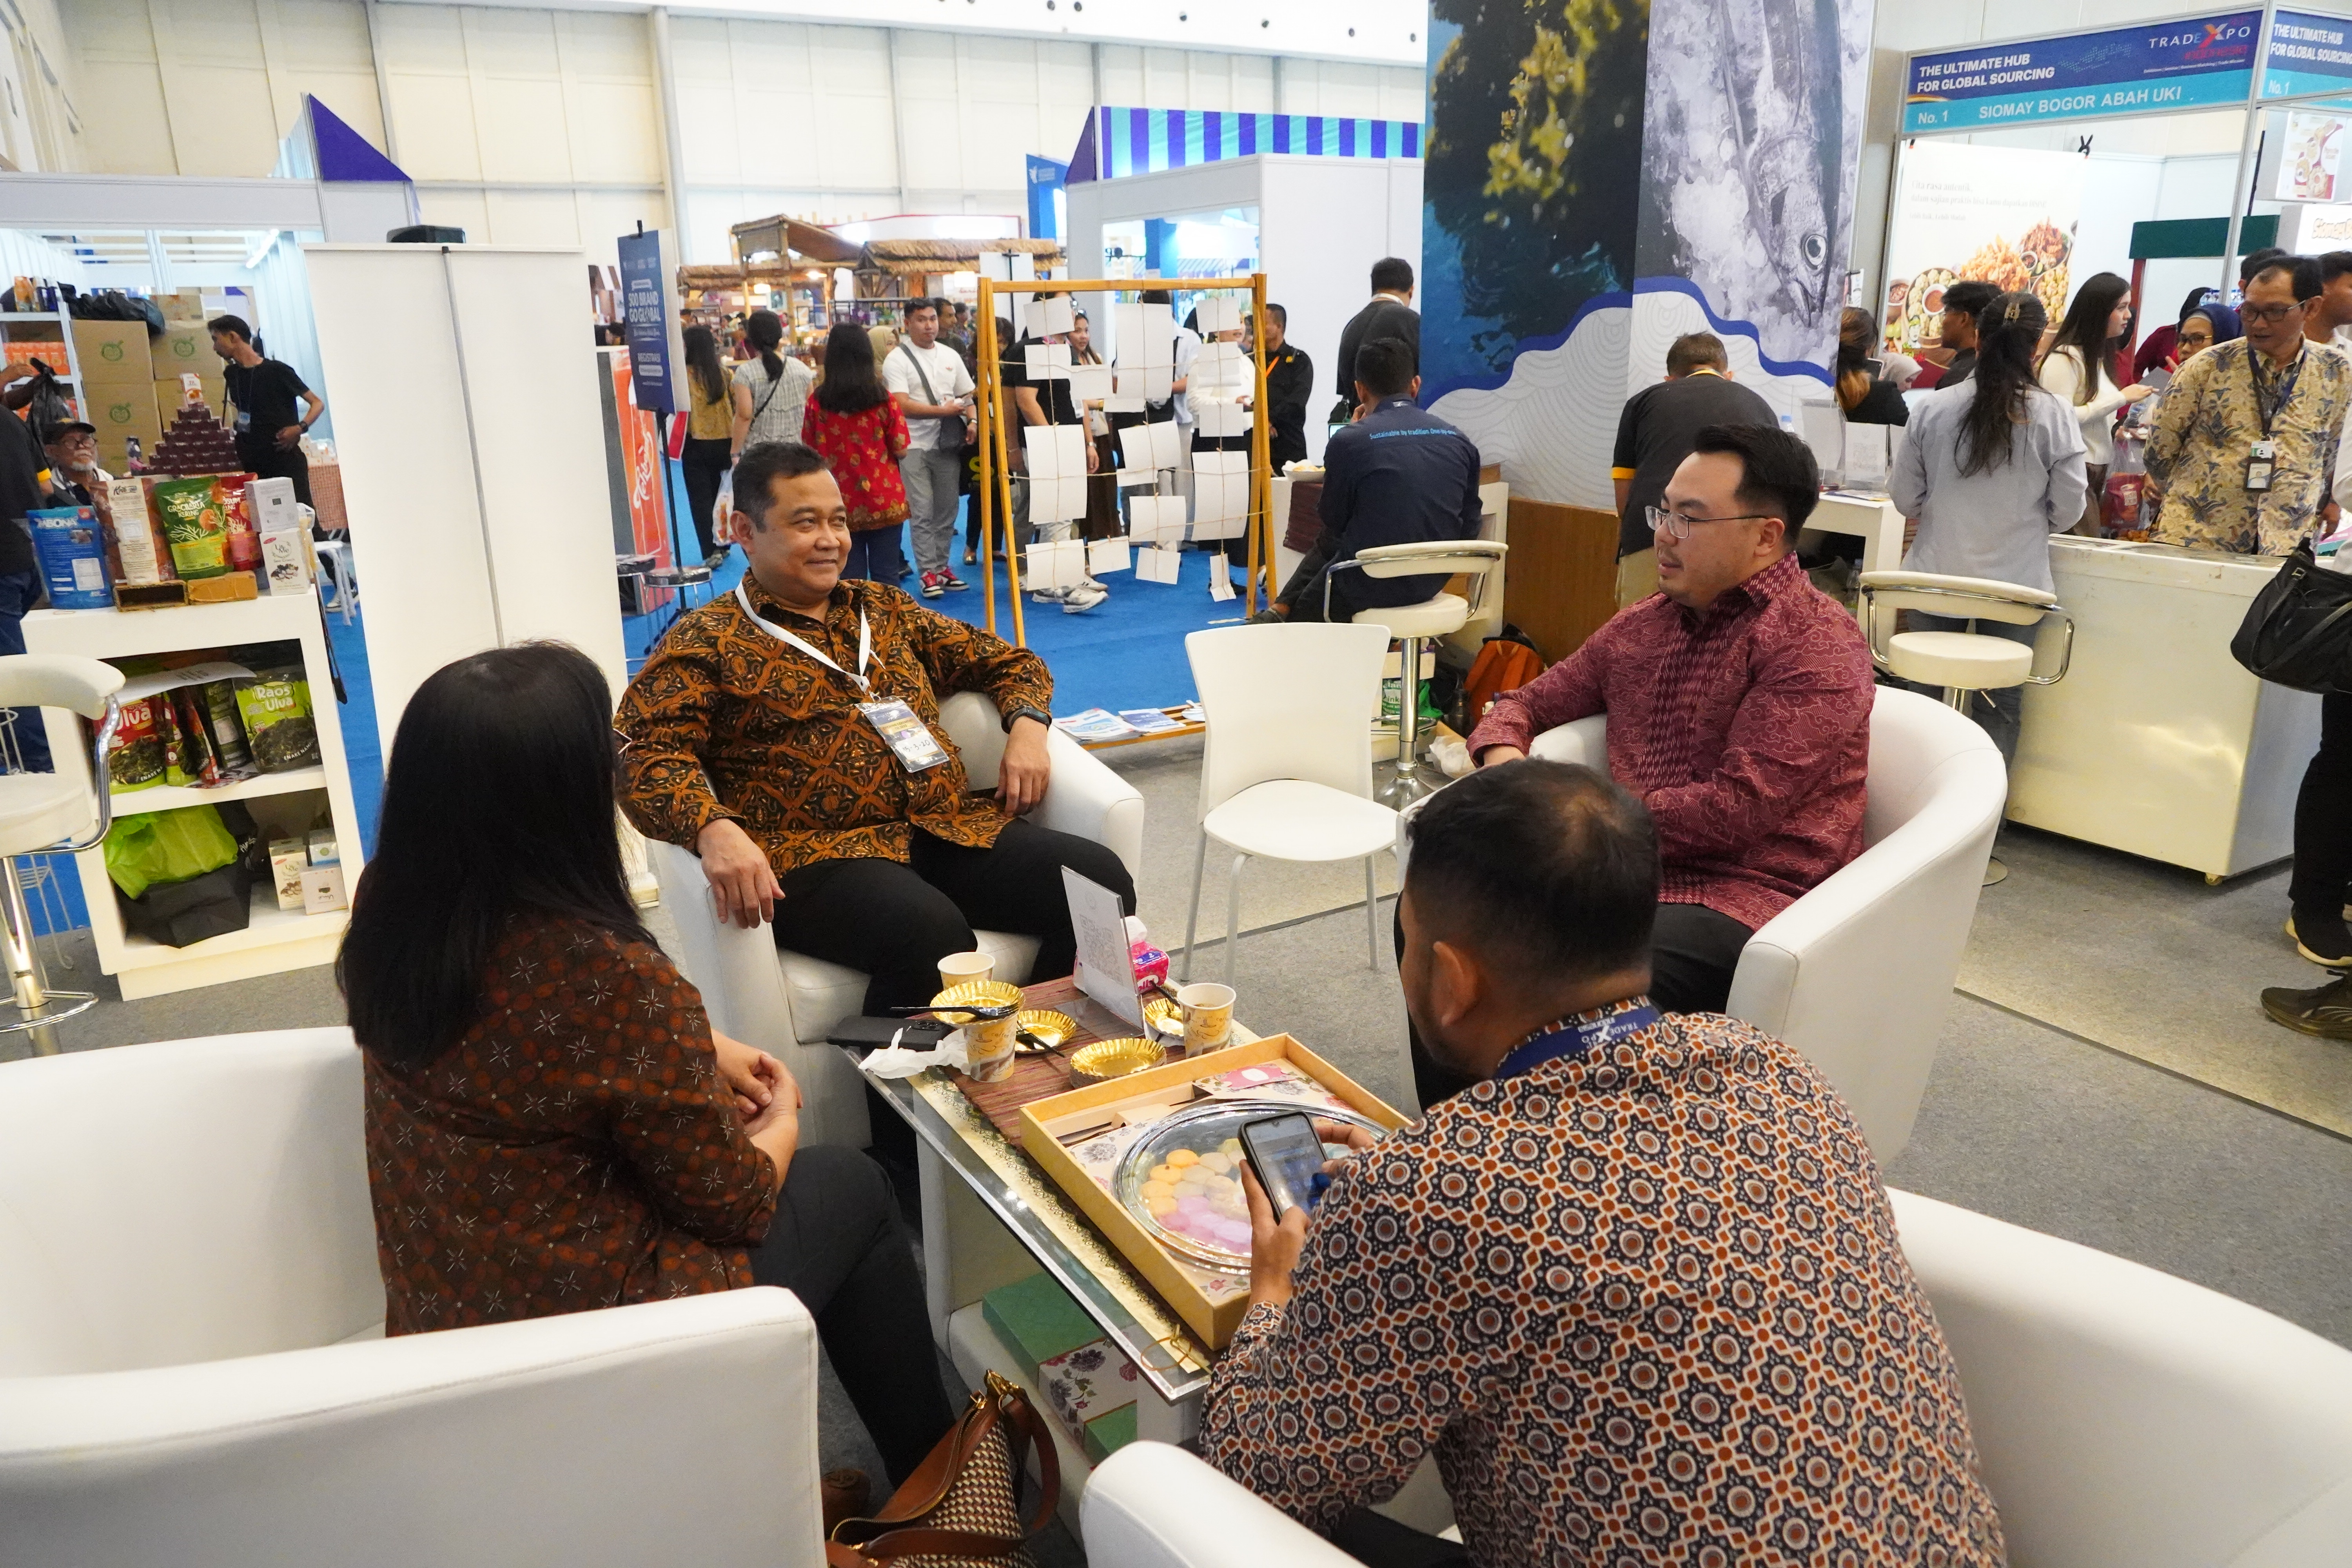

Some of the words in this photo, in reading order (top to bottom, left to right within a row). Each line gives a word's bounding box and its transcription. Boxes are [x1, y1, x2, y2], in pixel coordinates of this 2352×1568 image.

[2274, 24, 2291, 38] THE
[2290, 26, 2328, 43] ULTIMATE
[2327, 31, 2344, 45] HUB
[2270, 42, 2287, 56] FOR
[2287, 44, 2316, 60] GLOBAL
[1920, 64, 1941, 77] THE
[1944, 58, 2002, 75] ULTIMATE
[2004, 53, 2030, 67] HUB
[1917, 80, 1939, 93] FOR
[1942, 76, 1988, 90] GLOBAL
[1989, 67, 2055, 85] SOURCING
[2269, 80, 2282, 94] No.
[2285, 82, 2290, 94] 1
[1918, 113, 1937, 124] No.
[1942, 110, 1948, 122] 1
[1979, 101, 2034, 118] SIOMAY
[2039, 95, 2095, 113] BOGOR
[2101, 89, 2149, 107] ABAH
[2152, 86, 2181, 102] UKI
[629, 307, 638, 323] GO
[638, 306, 661, 323] GLOBAL
[167, 500, 205, 513] GRACILARIA
[178, 510, 199, 518] KERING
[256, 686, 290, 699] Raos
[266, 697, 293, 711] Ulva
